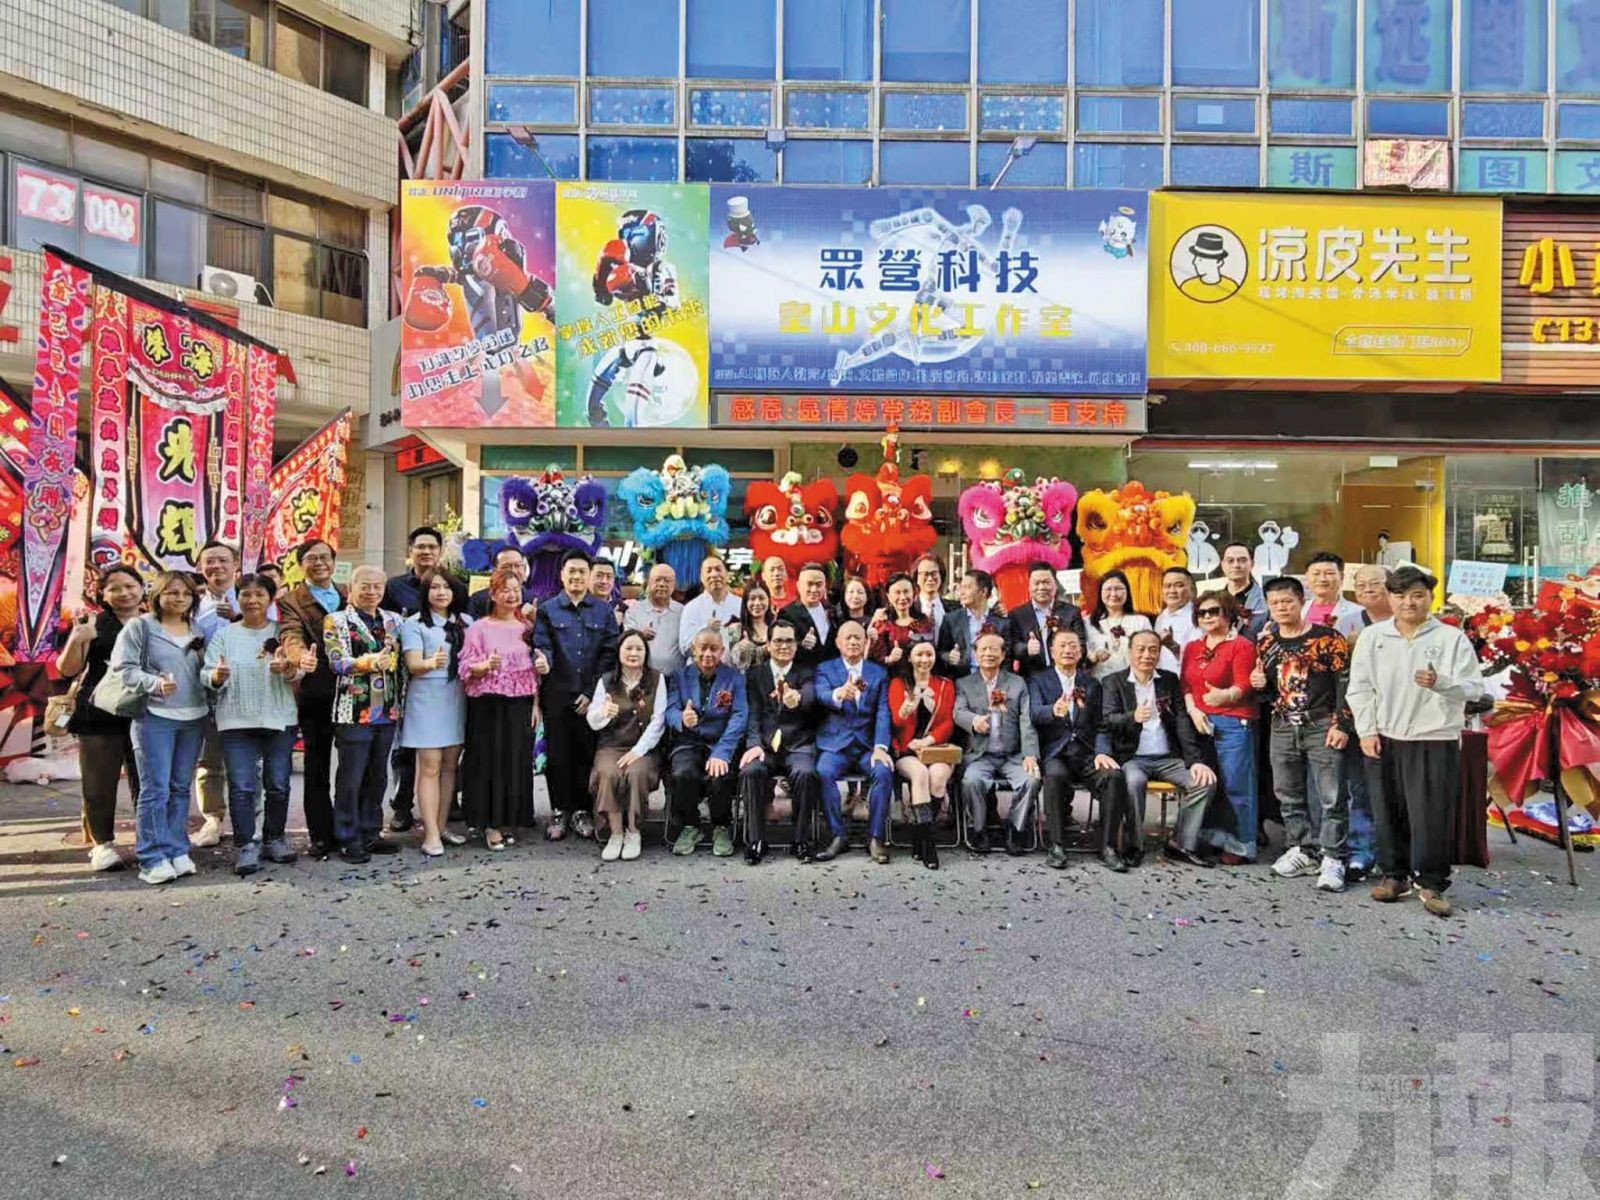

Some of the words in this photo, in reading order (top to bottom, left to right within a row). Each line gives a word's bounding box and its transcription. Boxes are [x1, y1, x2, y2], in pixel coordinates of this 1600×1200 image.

[1477, 155, 1527, 190] 图
[819, 248, 1040, 294] 眾營科技
[1258, 227, 1473, 284] 凉皮先生
[1519, 237, 1600, 294] 小
[1532, 316, 1600, 342] (13
